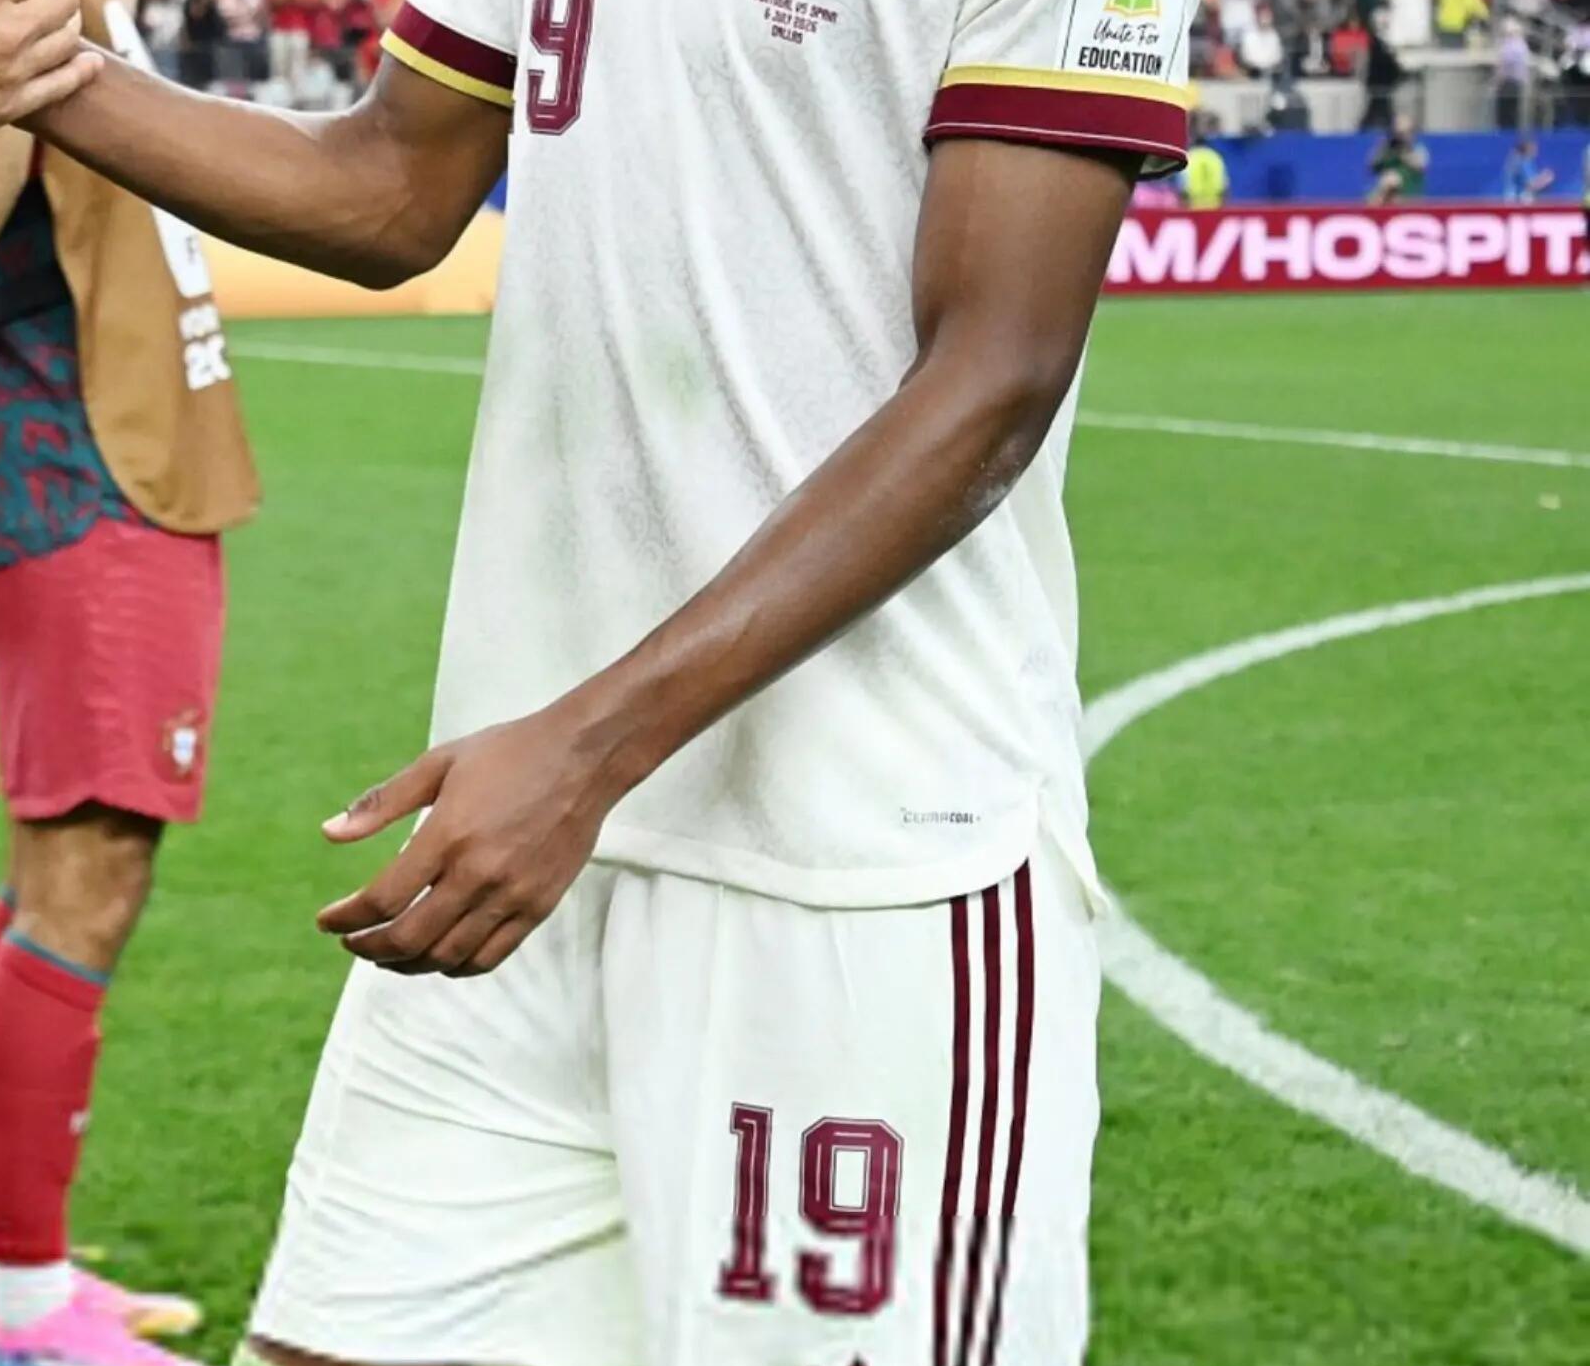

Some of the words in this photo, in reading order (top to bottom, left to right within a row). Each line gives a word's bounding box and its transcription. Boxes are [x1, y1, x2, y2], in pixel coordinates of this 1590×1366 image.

[1092, 18, 1135, 44] Unite
[1136, 22, 1160, 46] For
[1077, 46, 1163, 76] EDUCATION
[1109, 213, 1590, 283] M/HOSPIT
[716, 1100, 905, 1319] 19
